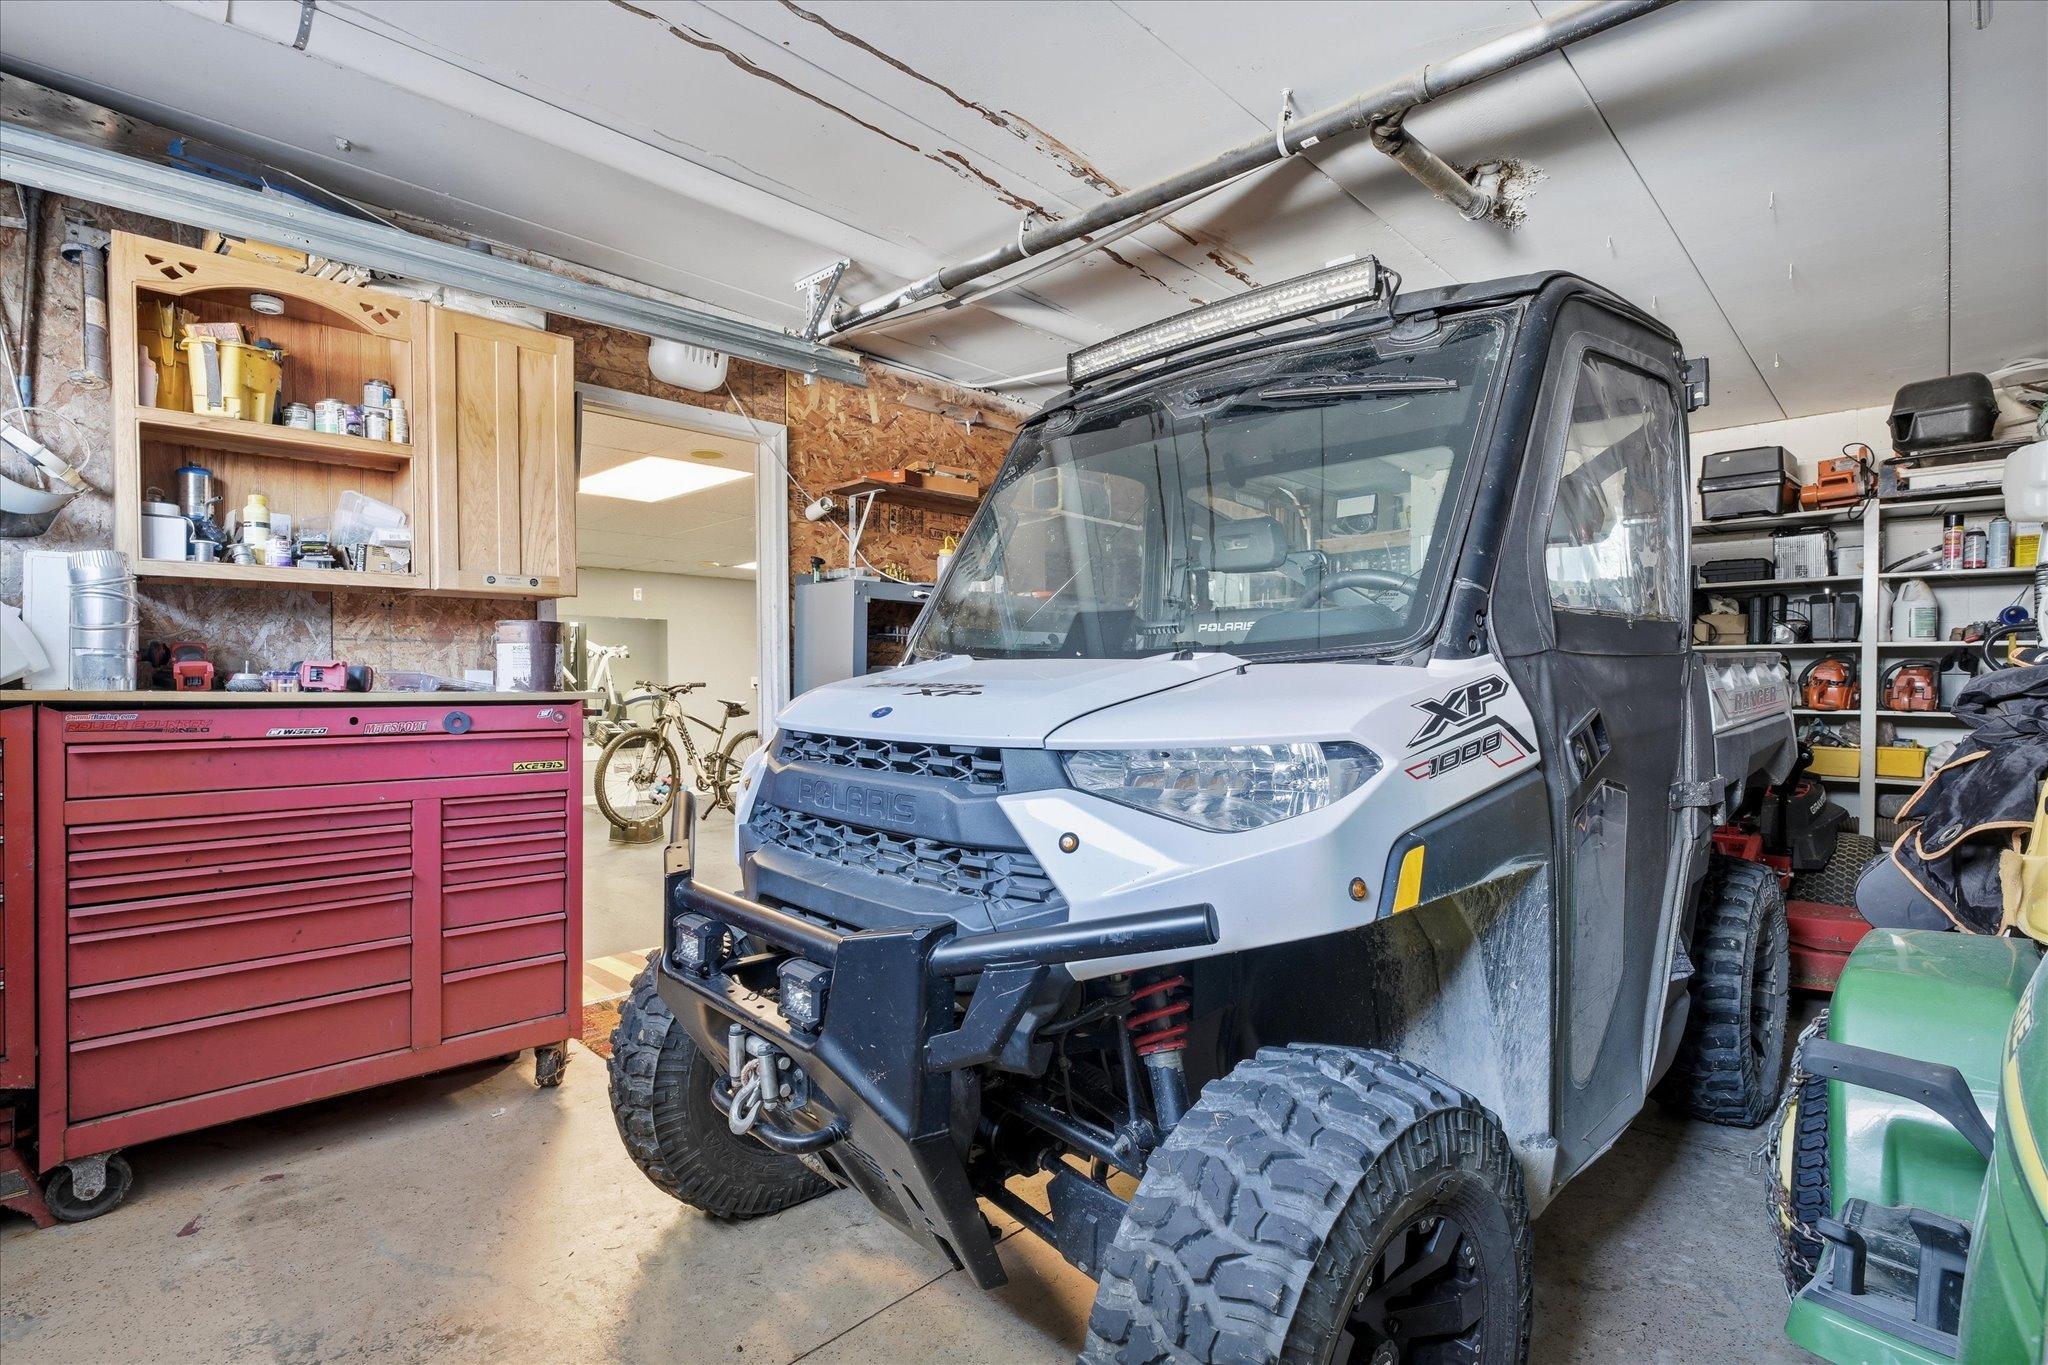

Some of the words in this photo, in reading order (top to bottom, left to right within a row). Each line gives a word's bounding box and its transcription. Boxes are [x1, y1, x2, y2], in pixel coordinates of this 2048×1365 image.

[1198, 621, 1256, 632] POLARIS
[1406, 674, 1509, 748] XP
[1734, 686, 1778, 713] RANGER
[65, 722, 128, 732] ROUGH
[131, 719, 213, 729] COUNTRY
[514, 761, 563, 771] ACERBIS
[1428, 729, 1501, 779] 1000
[797, 777, 918, 826] POLARIS
